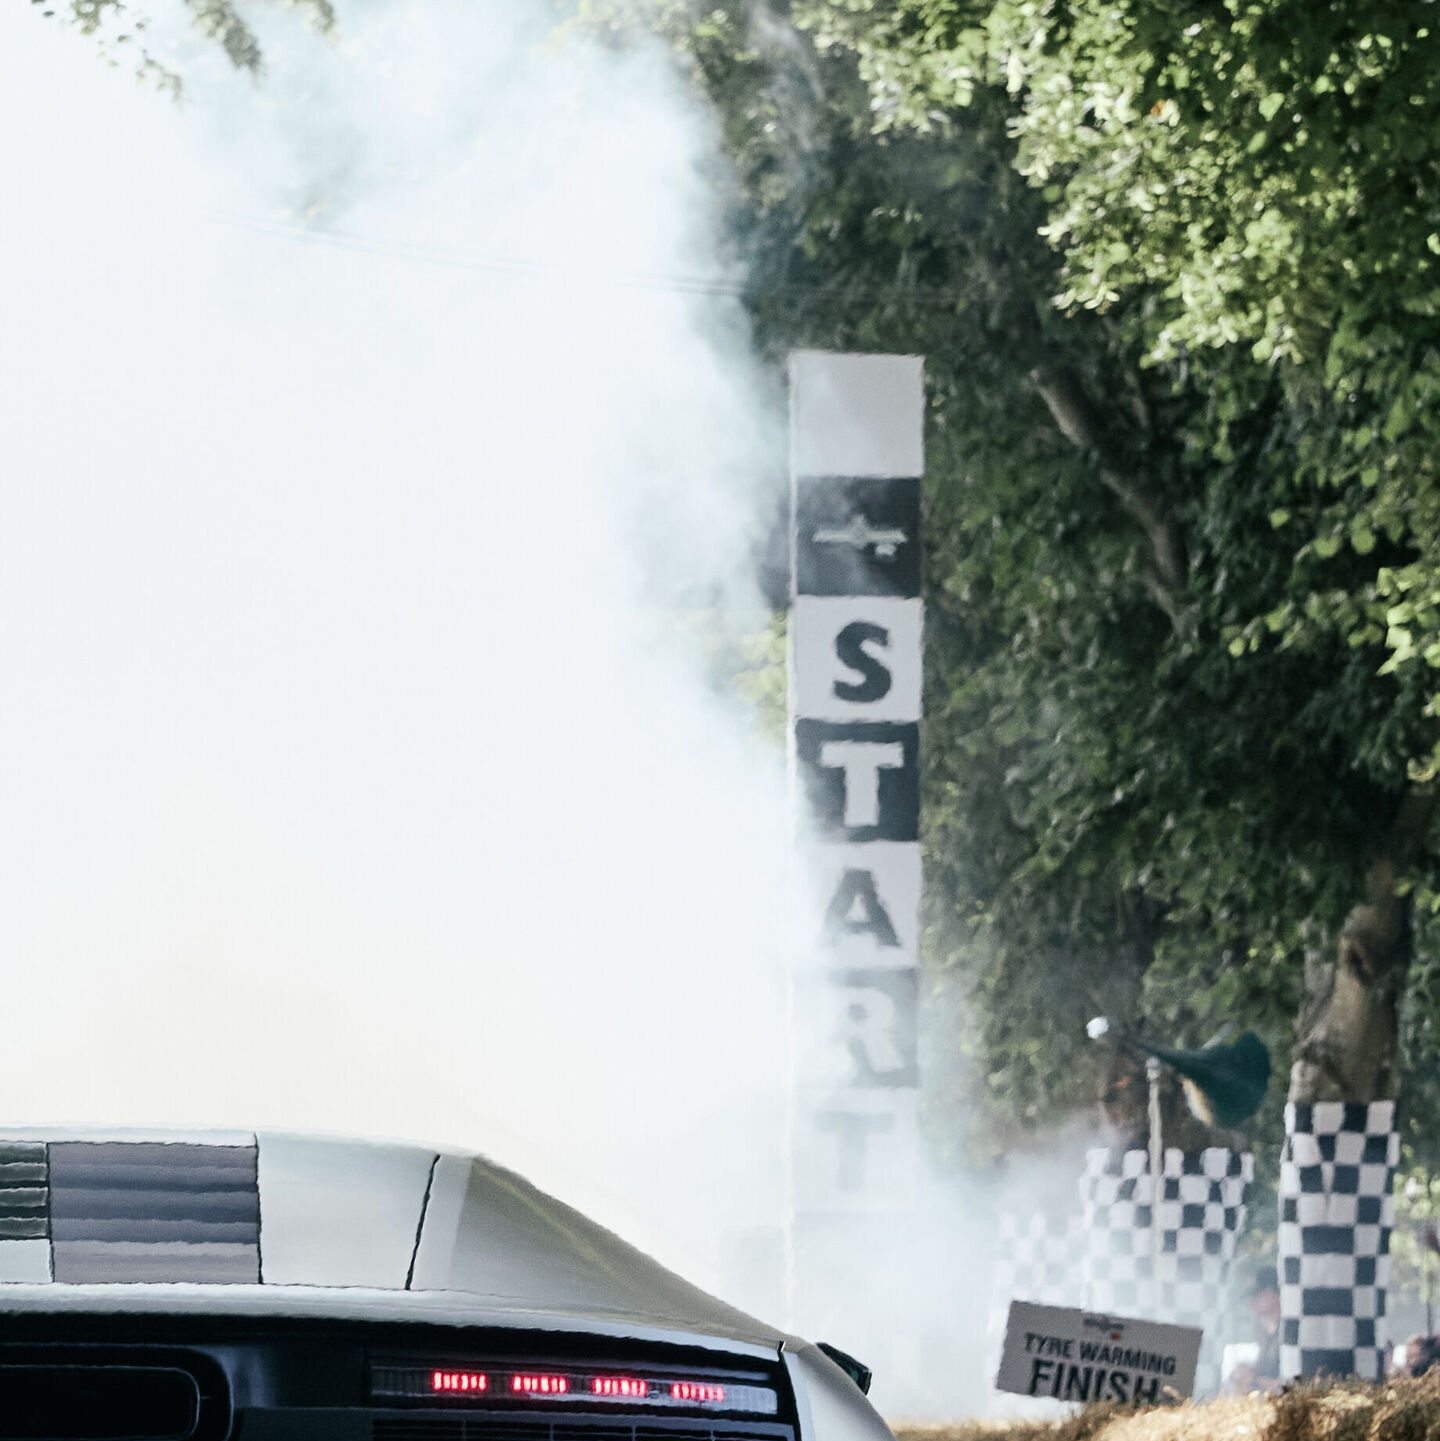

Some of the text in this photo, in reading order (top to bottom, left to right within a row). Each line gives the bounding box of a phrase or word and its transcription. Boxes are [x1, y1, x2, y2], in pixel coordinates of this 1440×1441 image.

[815, 620, 905, 1194] START
[1025, 1331, 1176, 1376] TYRE WARMING
[1028, 1357, 1159, 1410] FINISH
